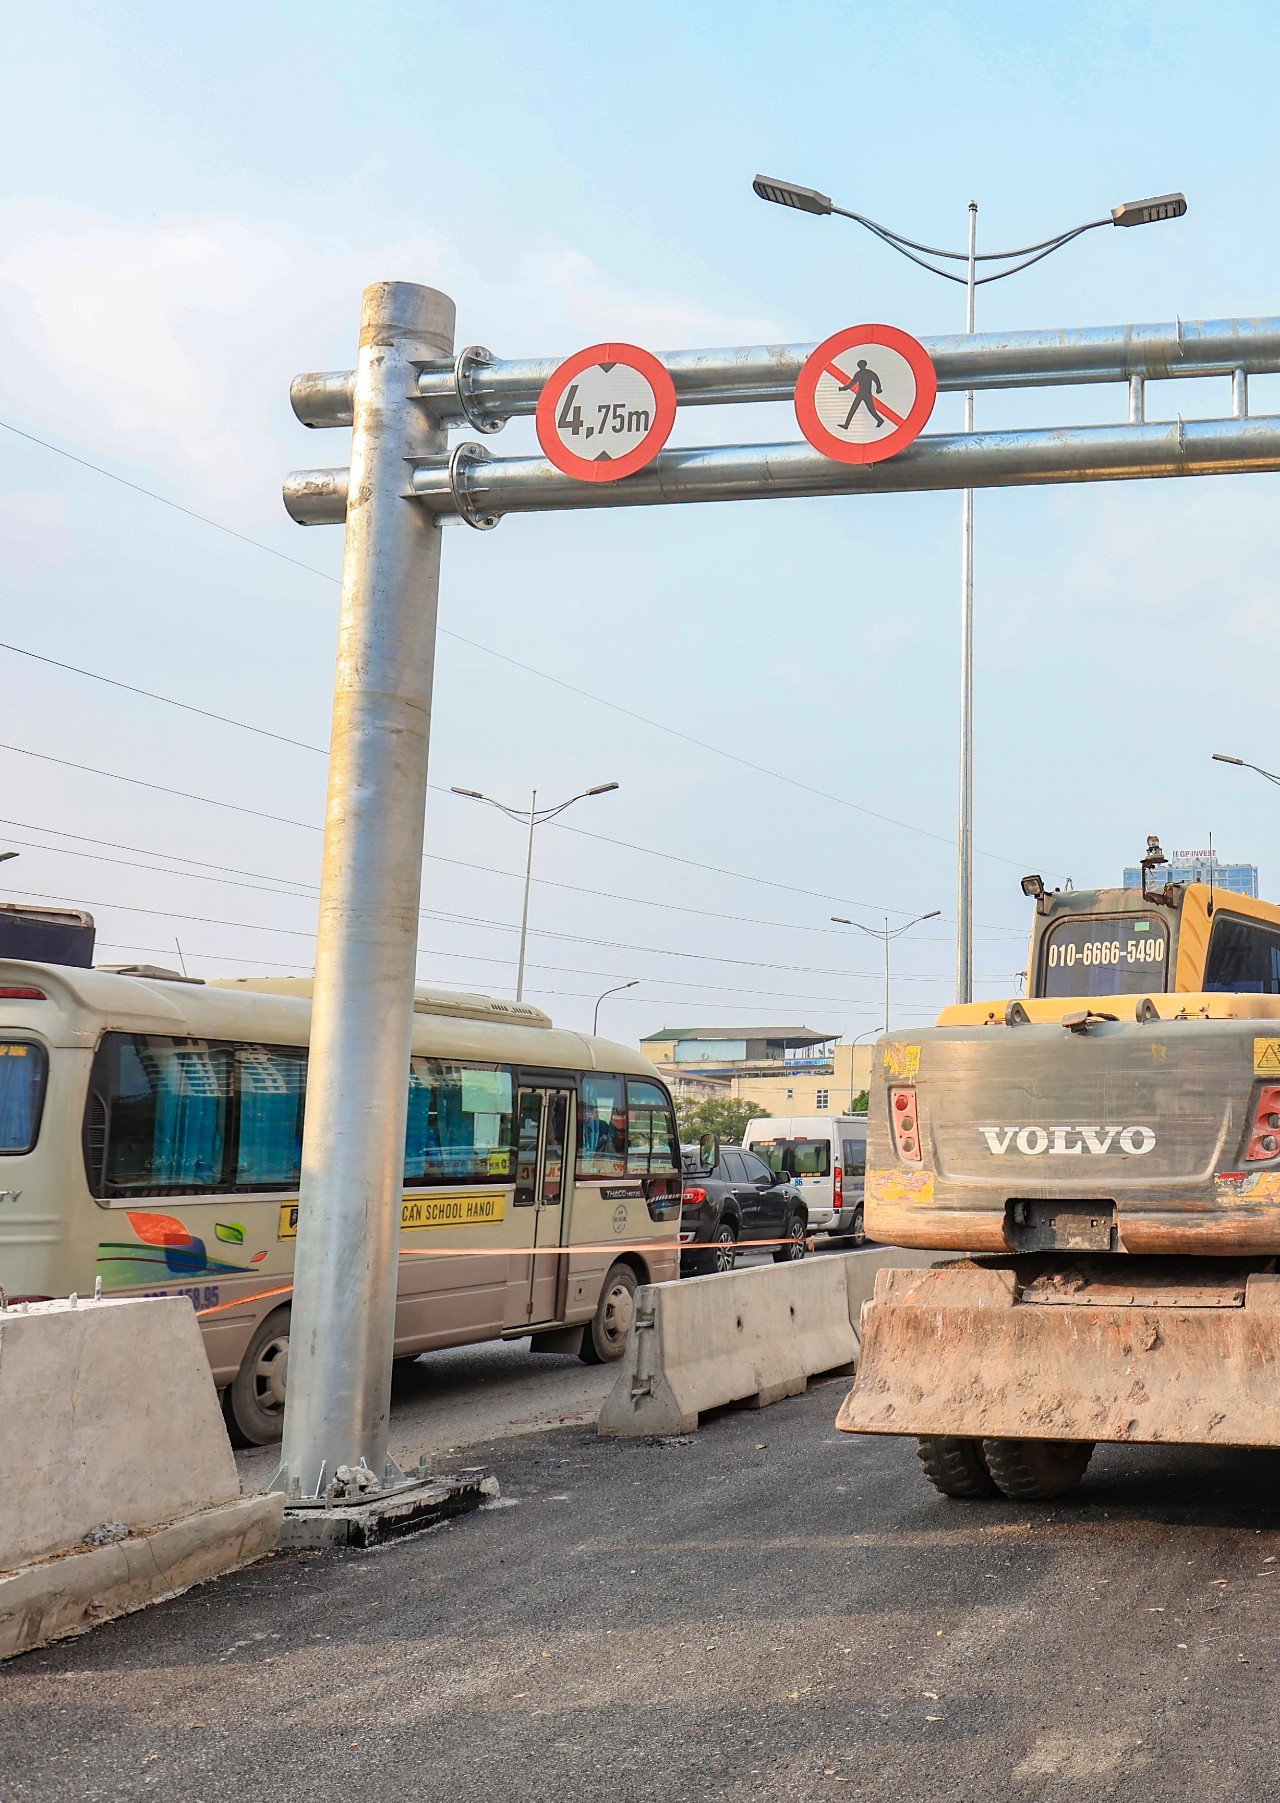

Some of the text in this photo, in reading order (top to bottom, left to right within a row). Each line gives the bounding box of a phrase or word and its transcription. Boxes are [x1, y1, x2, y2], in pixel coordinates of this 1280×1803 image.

[558, 385, 650, 440] 4,75m
[1048, 938, 1165, 968] 010-6666-5490
[978, 1126, 1157, 1155] VOLVO
[402, 1201, 495, 1222] CAN SCHOOL HANOI
